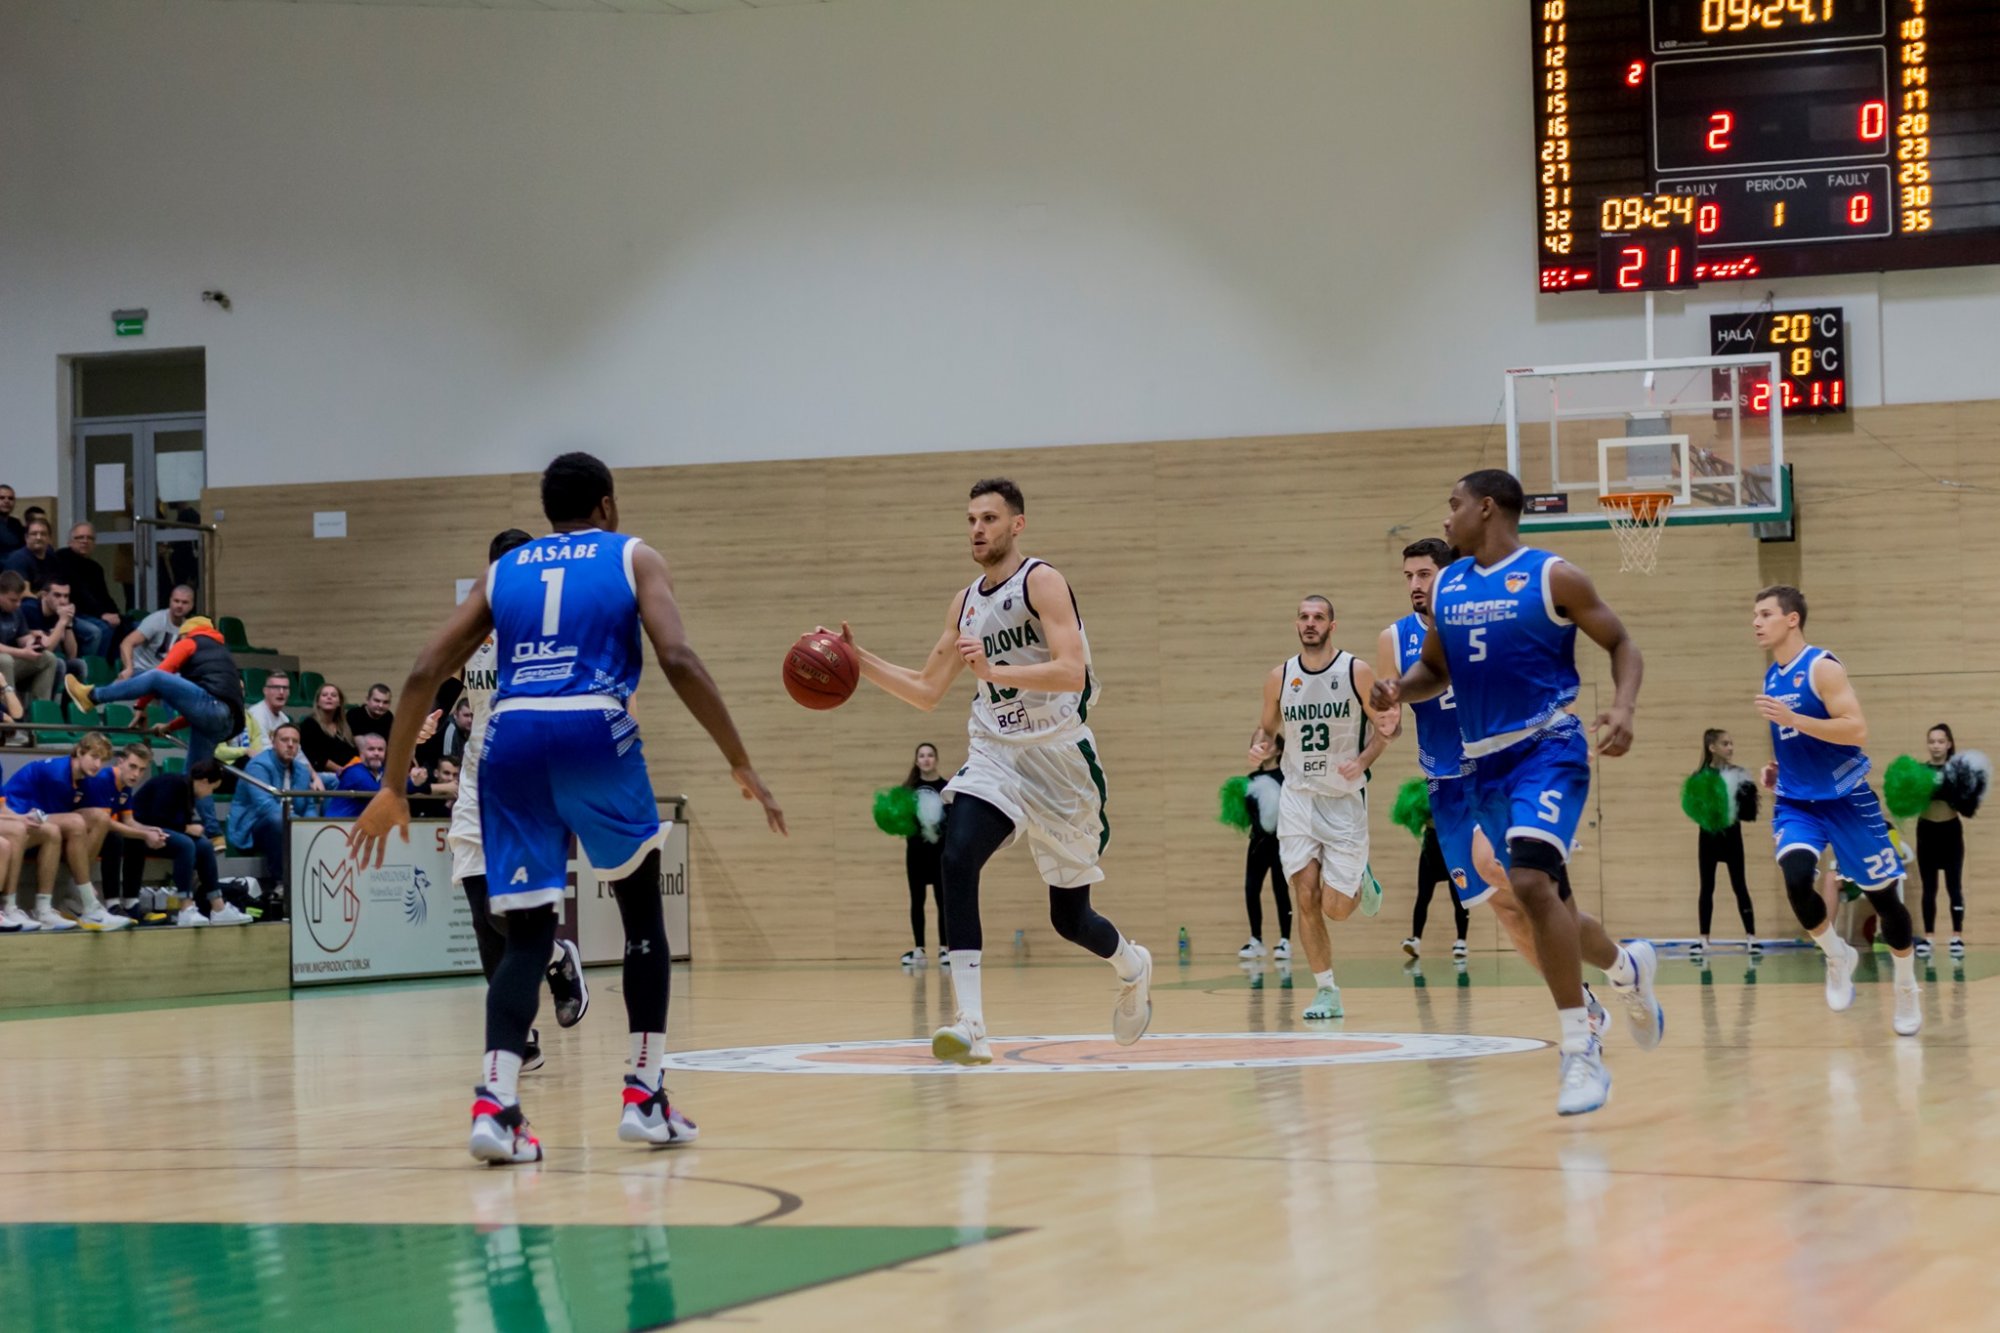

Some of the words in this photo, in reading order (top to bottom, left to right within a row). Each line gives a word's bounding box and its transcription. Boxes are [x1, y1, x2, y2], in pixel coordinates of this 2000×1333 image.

[1544, 0, 1564, 20] 10
[1544, 24, 1566, 43] 11
[1901, 17, 1926, 40] 10
[1545, 45, 1566, 67] 12
[1902, 41, 1927, 64] 12
[1546, 69, 1567, 90] 13
[1627, 62, 1643, 85] 2
[1903, 66, 1928, 87] 14
[1547, 93, 1567, 113] 15
[1903, 88, 1929, 111] 17
[1547, 116, 1568, 136] 16
[1707, 111, 1734, 151] 2
[1859, 101, 1885, 141] 0
[1898, 113, 1929, 136] 20
[1541, 140, 1570, 161] 23
[1898, 137, 1930, 160] 23
[1542, 162, 1570, 184] 27
[1746, 176, 1807, 192] PERIÓDA
[1828, 173, 1870, 187] FAULY
[1899, 161, 1930, 184] 25
[1544, 187, 1571, 207] 31
[1901, 184, 1932, 208] 30
[1699, 204, 1718, 233] 0
[1773, 201, 1785, 227] 1
[1850, 194, 1870, 223] 0
[1902, 208, 1932, 232] 35
[1544, 210, 1571, 231] 32
[1544, 233, 1572, 254] 42
[1618, 246, 1680, 288] 21
[1718, 329, 1754, 341] HALA
[516, 543, 599, 566] BASABE
[541, 567, 565, 636] 1
[983, 619, 1040, 658] DLOVÁ
[1469, 628, 1487, 662] 5
[467, 669, 498, 690] HAN
[998, 708, 1026, 728] BCF
[1284, 699, 1350, 722] HANDLOVÁ
[1301, 723, 1330, 752] 23
[1304, 761, 1326, 772] BCF
[1863, 848, 1898, 879] 23
